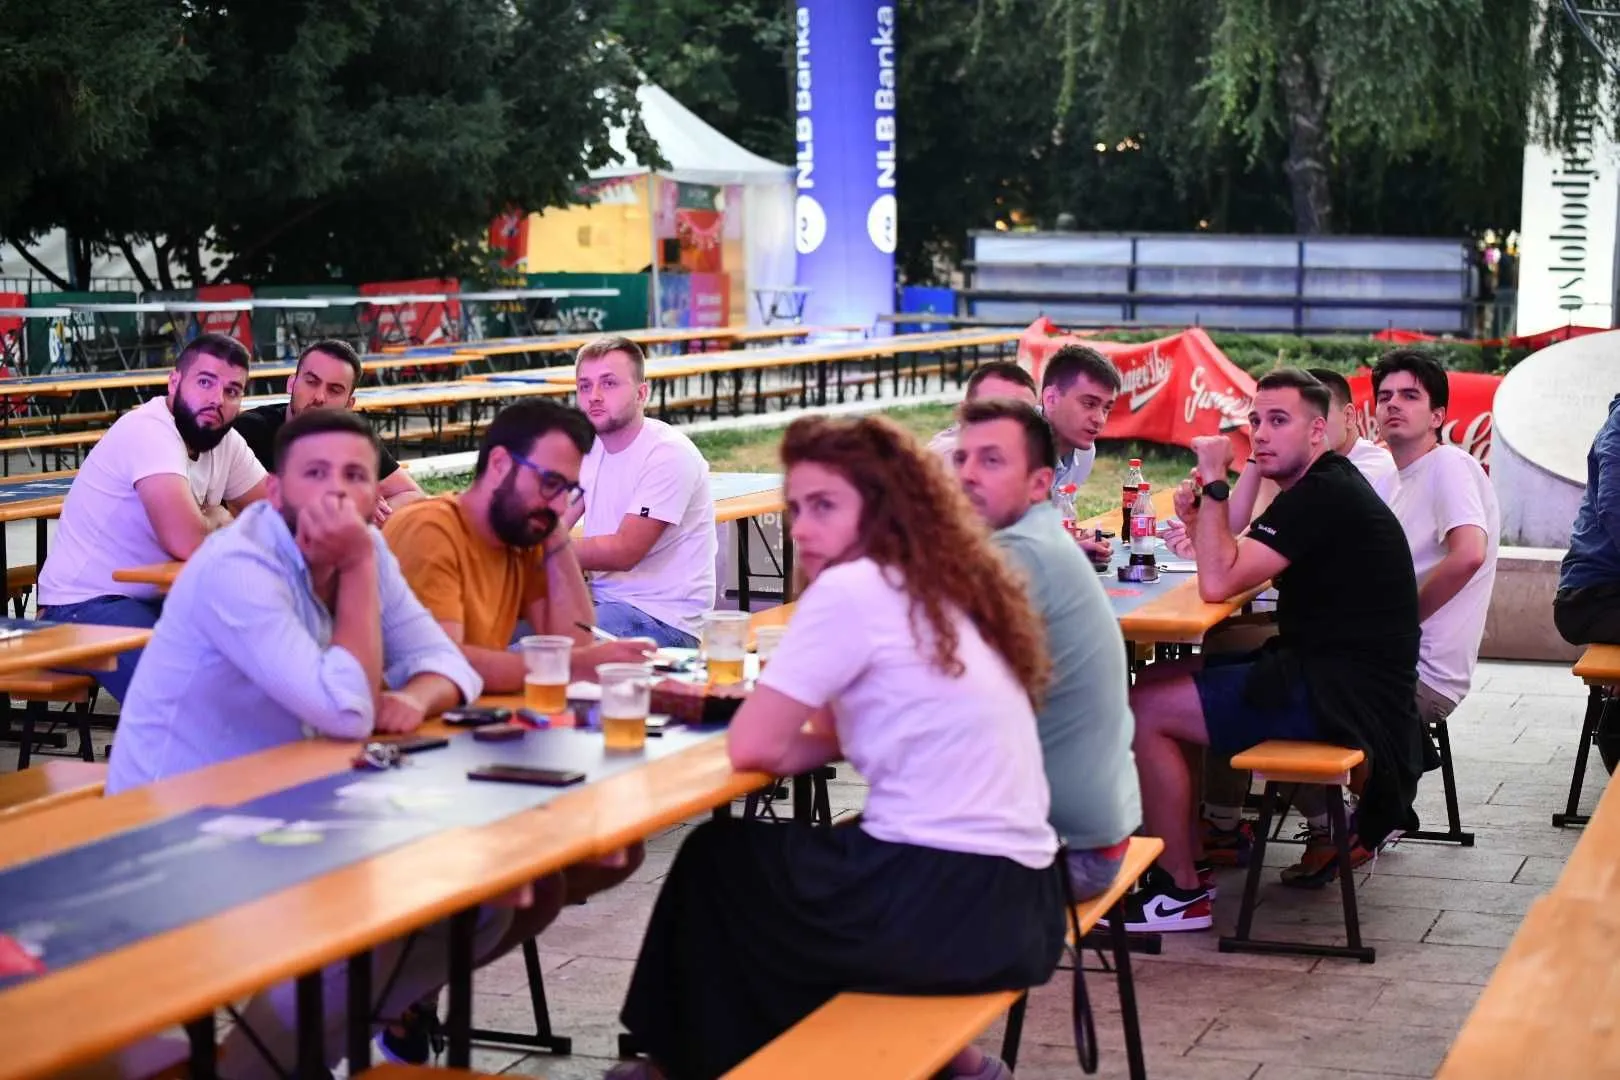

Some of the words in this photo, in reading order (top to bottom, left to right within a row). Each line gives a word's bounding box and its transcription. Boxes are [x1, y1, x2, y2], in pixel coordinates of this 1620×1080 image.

[871, 6, 896, 110] Banka
[796, 116, 814, 188] NLB
[874, 115, 896, 189] NLB
